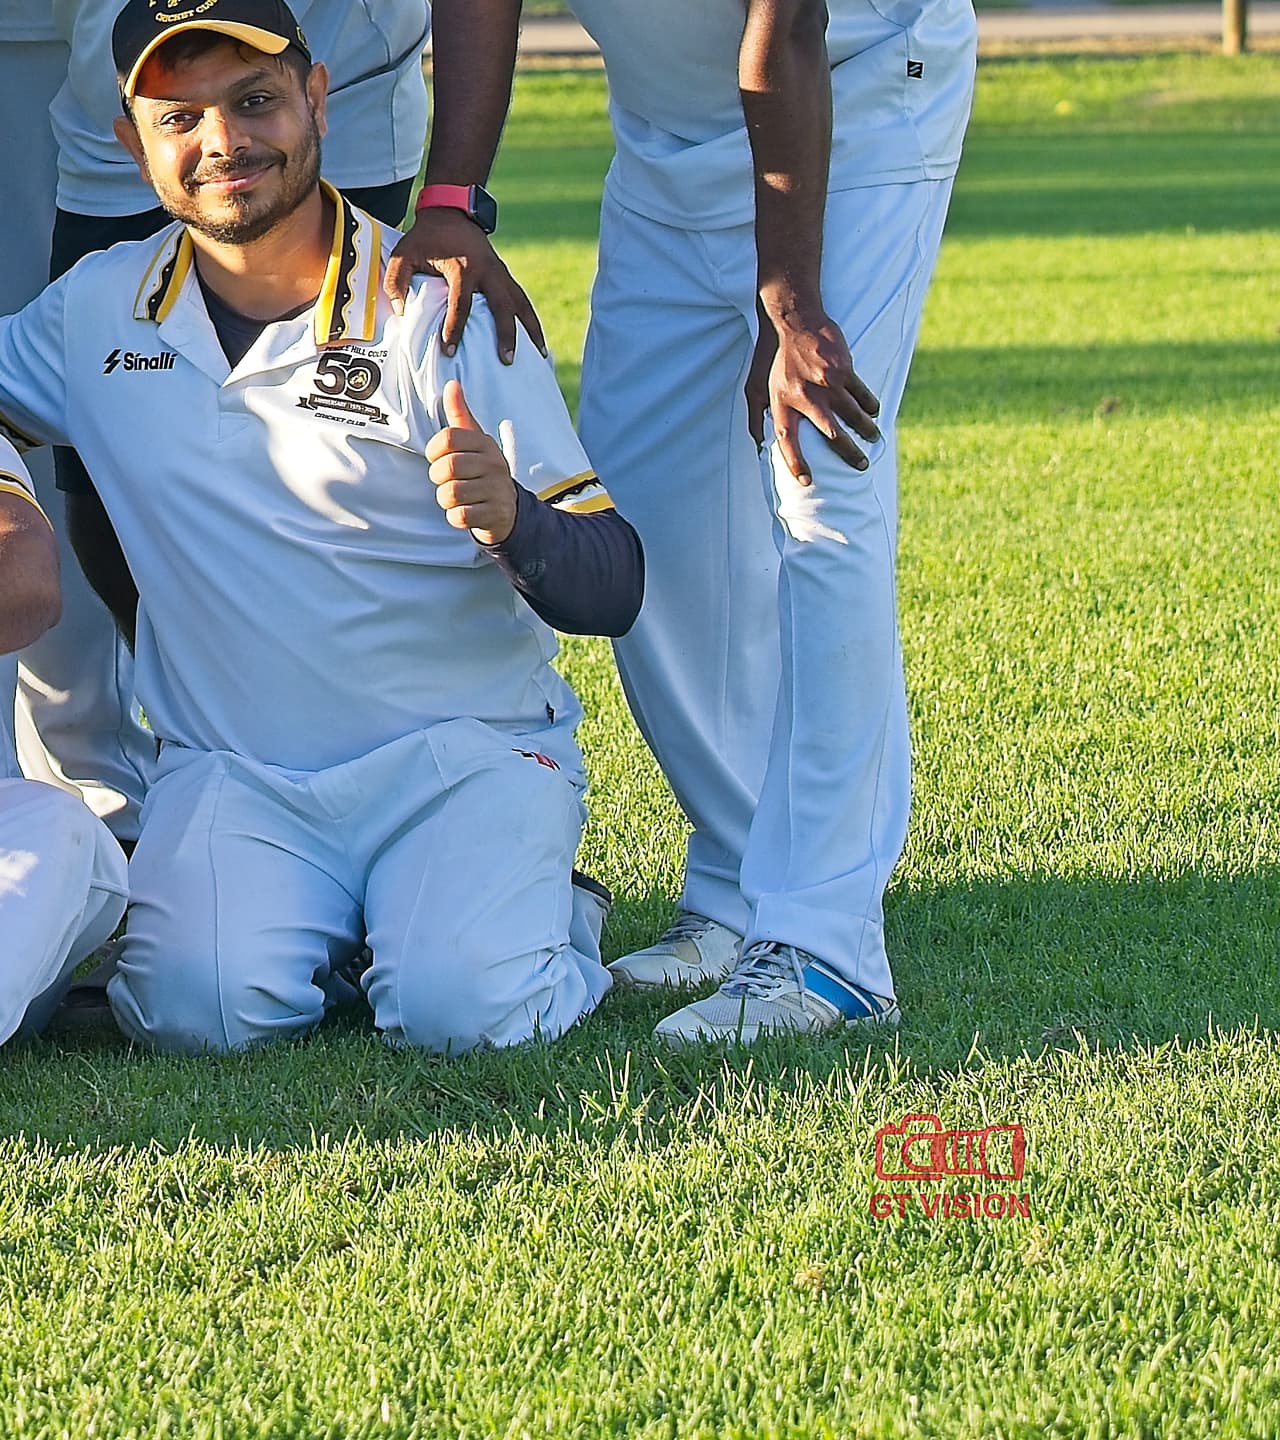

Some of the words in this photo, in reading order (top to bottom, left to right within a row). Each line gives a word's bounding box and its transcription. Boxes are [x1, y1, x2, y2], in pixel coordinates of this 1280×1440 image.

[350, 345, 366, 356] HILL
[123, 352, 178, 371] Sinalli
[313, 352, 382, 400] 50
[314, 412, 347, 423] CRICKET
